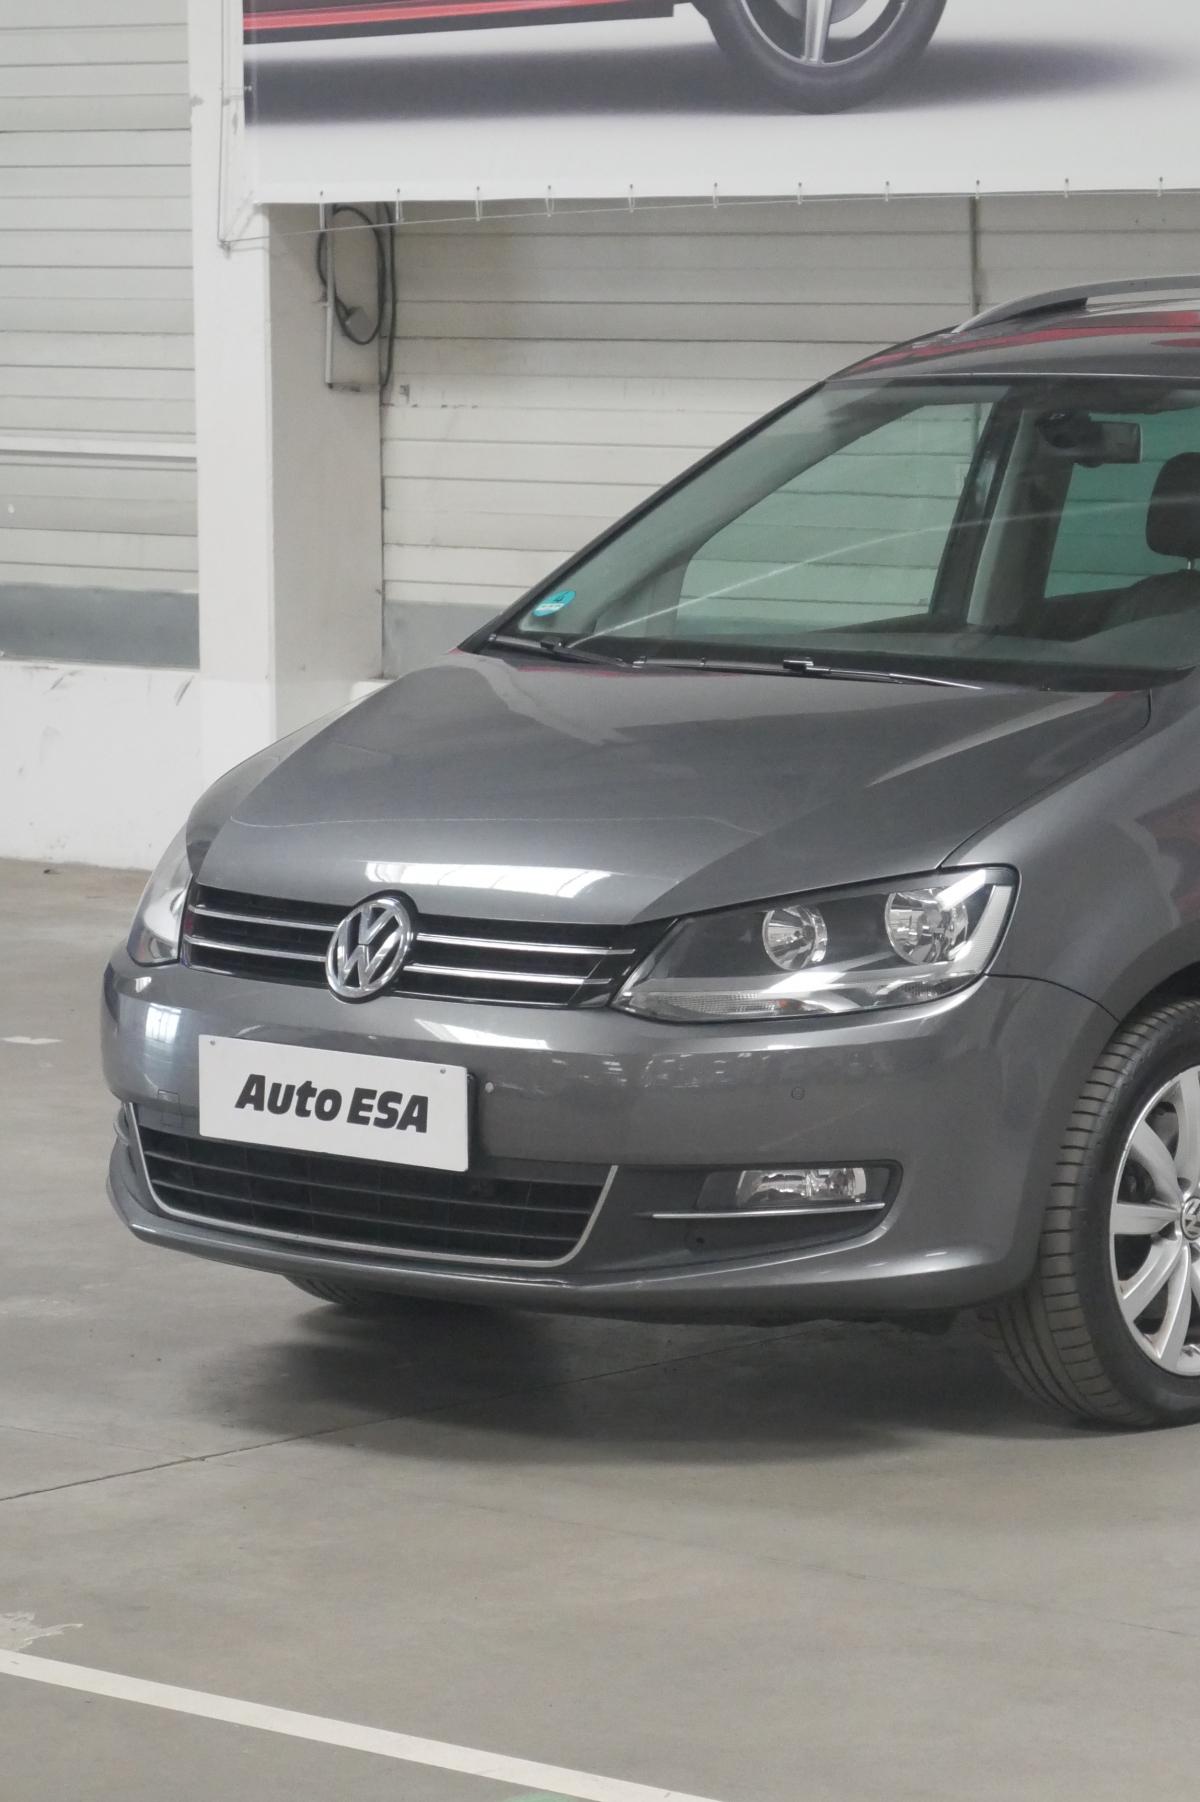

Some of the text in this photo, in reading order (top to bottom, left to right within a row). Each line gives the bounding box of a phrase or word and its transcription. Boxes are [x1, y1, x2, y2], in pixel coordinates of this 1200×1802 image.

[326, 898, 411, 998] VW
[235, 1074, 429, 1133] Auto ESA
